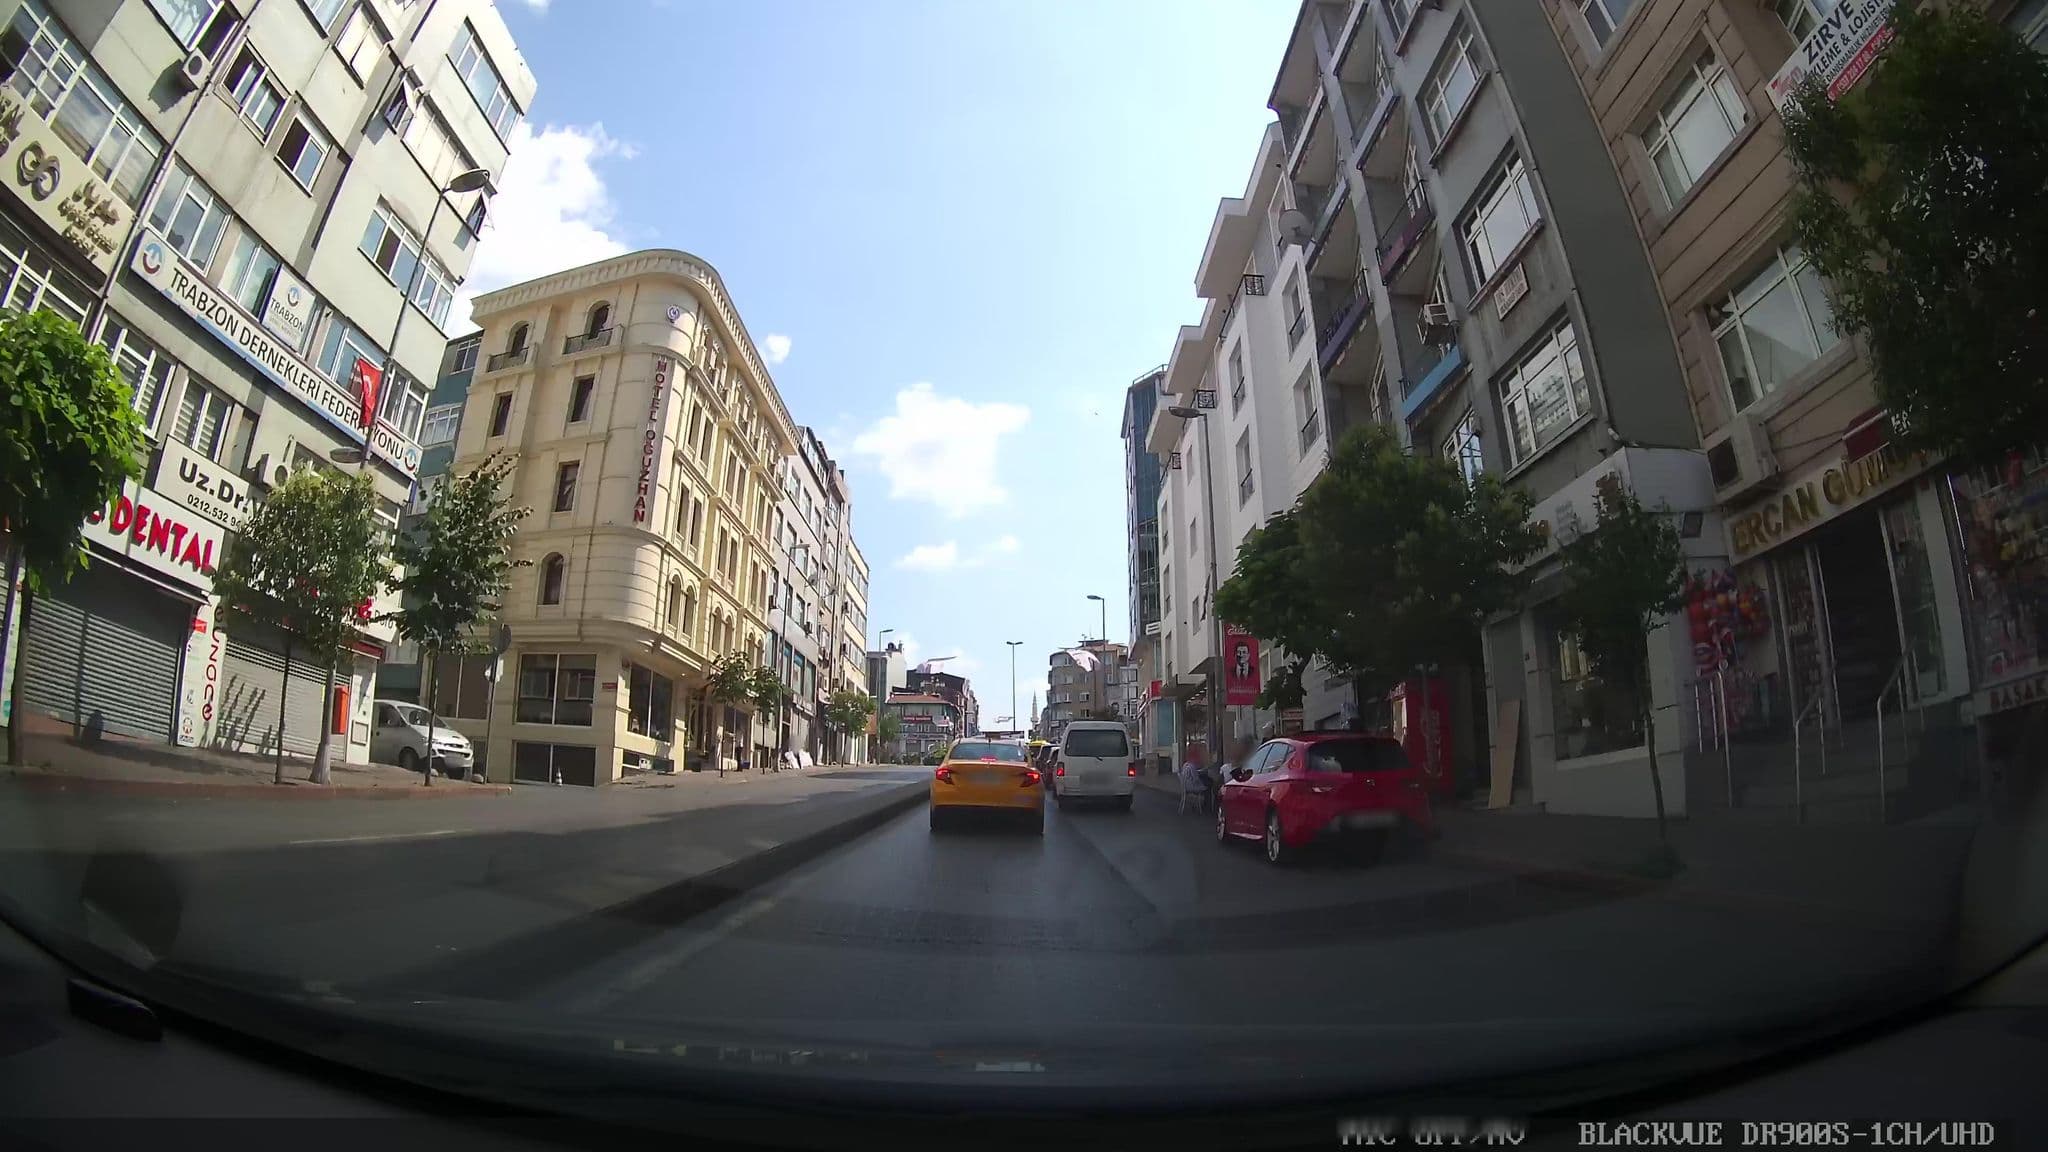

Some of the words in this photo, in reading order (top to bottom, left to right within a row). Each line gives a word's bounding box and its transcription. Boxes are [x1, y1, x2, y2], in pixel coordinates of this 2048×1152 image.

[1840, 33, 1851, 46] &
[271, 297, 305, 332] TRABZON
[170, 268, 239, 336] TRABZON
[239, 326, 322, 401] DERNEKLERİ
[322, 389, 405, 460] FEDERAYONU
[649, 360, 667, 422] HOTEL
[109, 495, 216, 577] DENTAL
[1732, 482, 1821, 552] ERCAN
